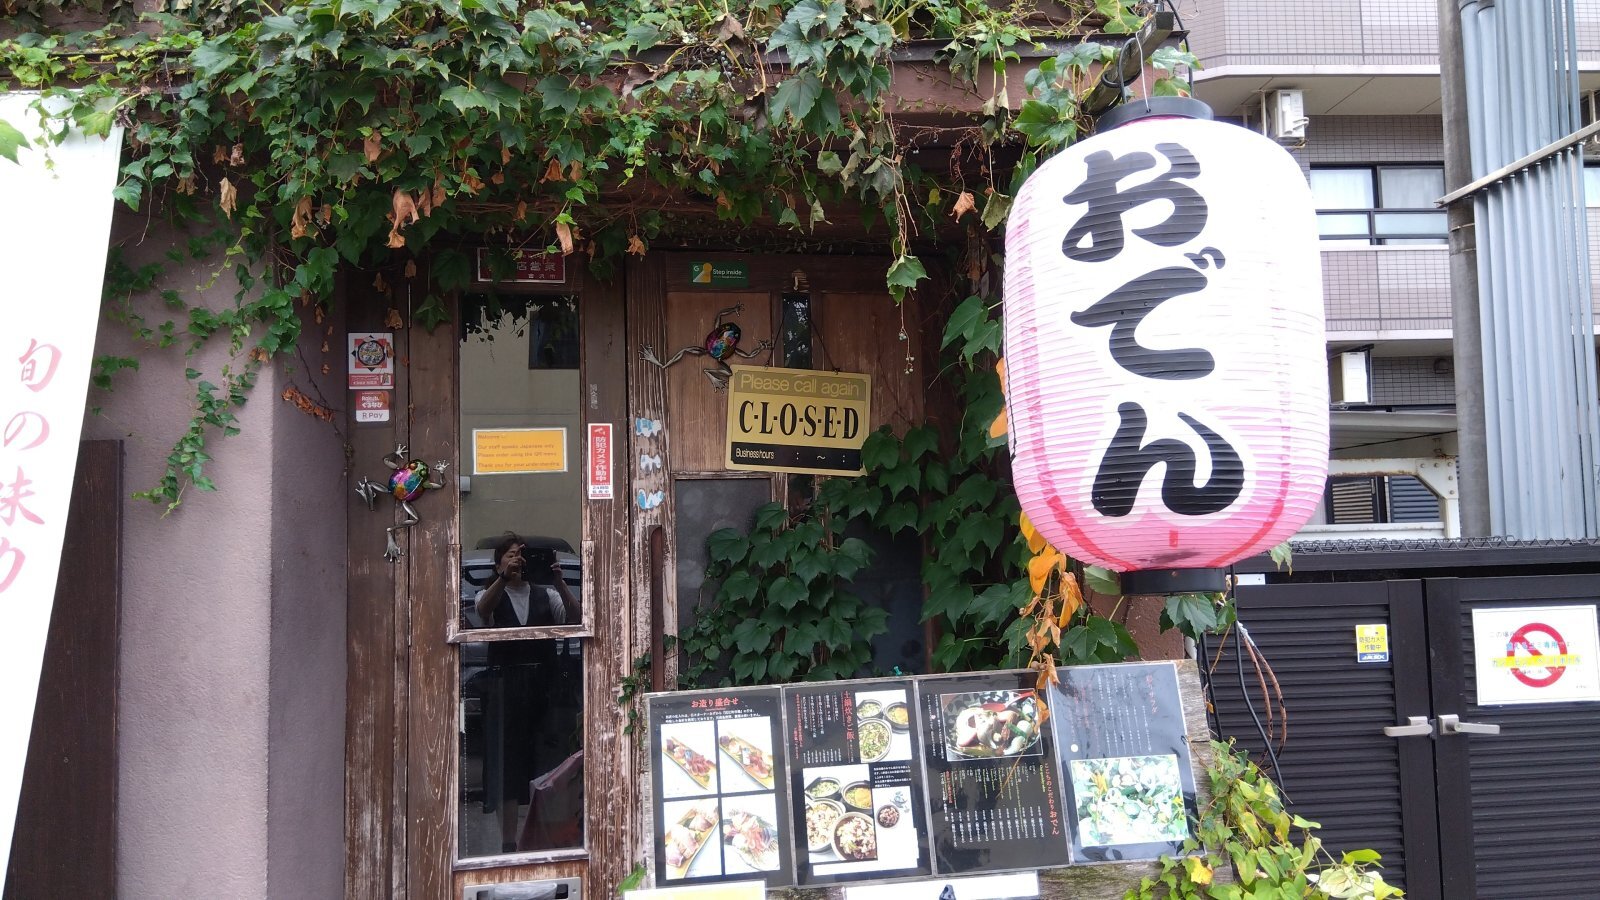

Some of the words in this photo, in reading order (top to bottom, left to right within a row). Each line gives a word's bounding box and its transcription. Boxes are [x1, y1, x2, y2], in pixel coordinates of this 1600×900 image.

[1062, 142, 1245, 518] おでん
[741, 374, 790, 392] Please
[794, 378, 817, 394] call
[821, 382, 859, 398] again
[595, 436, 607, 482] 防犯カメラ作動中
[691, 697, 739, 708] お造り盛合せ
